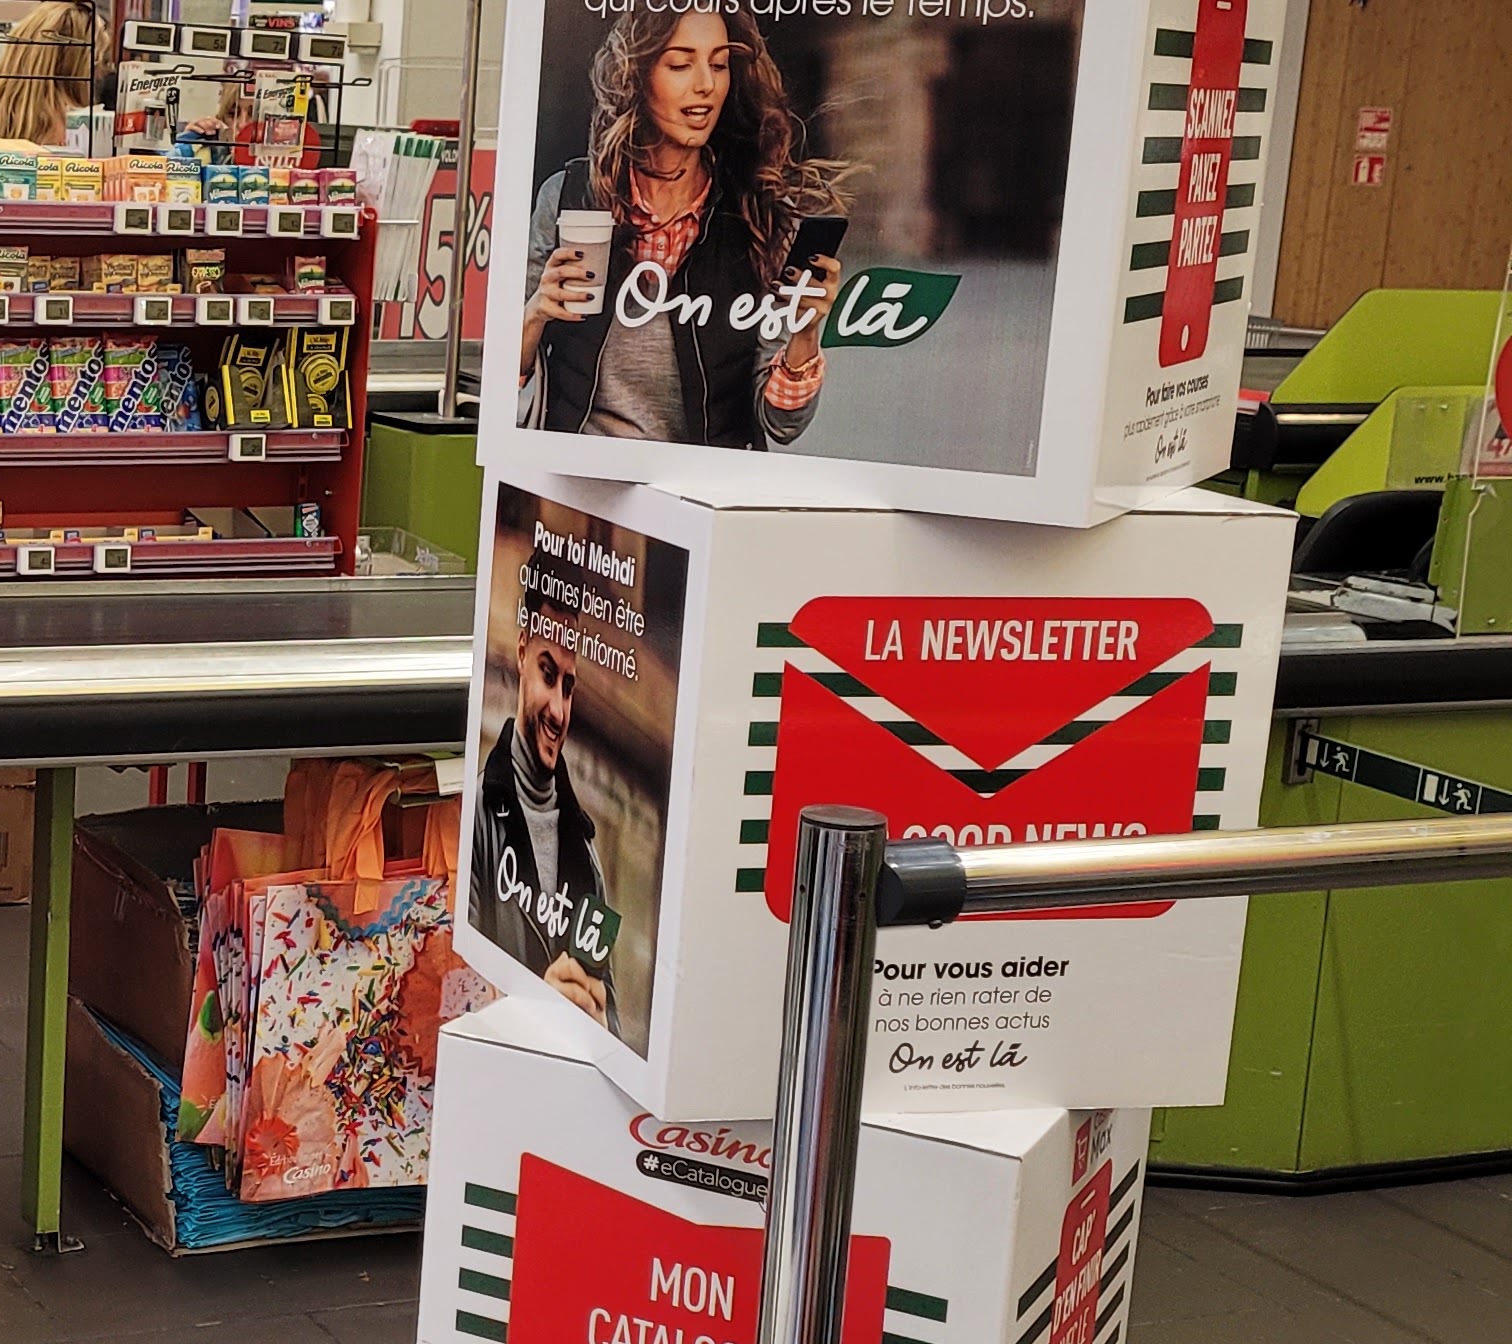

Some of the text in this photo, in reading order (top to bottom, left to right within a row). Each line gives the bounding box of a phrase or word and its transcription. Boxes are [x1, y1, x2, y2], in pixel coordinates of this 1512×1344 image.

[268, 16, 296, 28] VINS
[129, 75, 180, 92] Energizer
[1187, 87, 1235, 139] SCANNEZ
[1187, 153, 1221, 204] PAYEZ
[1176, 215, 1218, 268] PARTEZ
[615, 260, 710, 330] On
[730, 271, 828, 332] est
[534, 520, 636, 588] Pour toi Mehdi
[519, 563, 645, 637] qui aimes bien être
[516, 598, 640, 682] le premier informé.
[865, 619, 1139, 663] LA NEWSLETTER
[497, 847, 534, 913] On
[537, 870, 572, 942] est
[874, 955, 1070, 980] Pour vous aider
[878, 985, 1052, 1007] à ne rien rater de
[875, 1011, 1050, 1033] nos bonnes actus
[889, 1042, 934, 1073] On
[941, 1040, 985, 1072] est
[1090, 1124, 1113, 1166] Max
[283, 1163, 331, 1185] Casino
[642, 1154, 768, 1197] #eCatalogue
[649, 1257, 735, 1321] MON
[1075, 1247, 1103, 1302] FINIR
